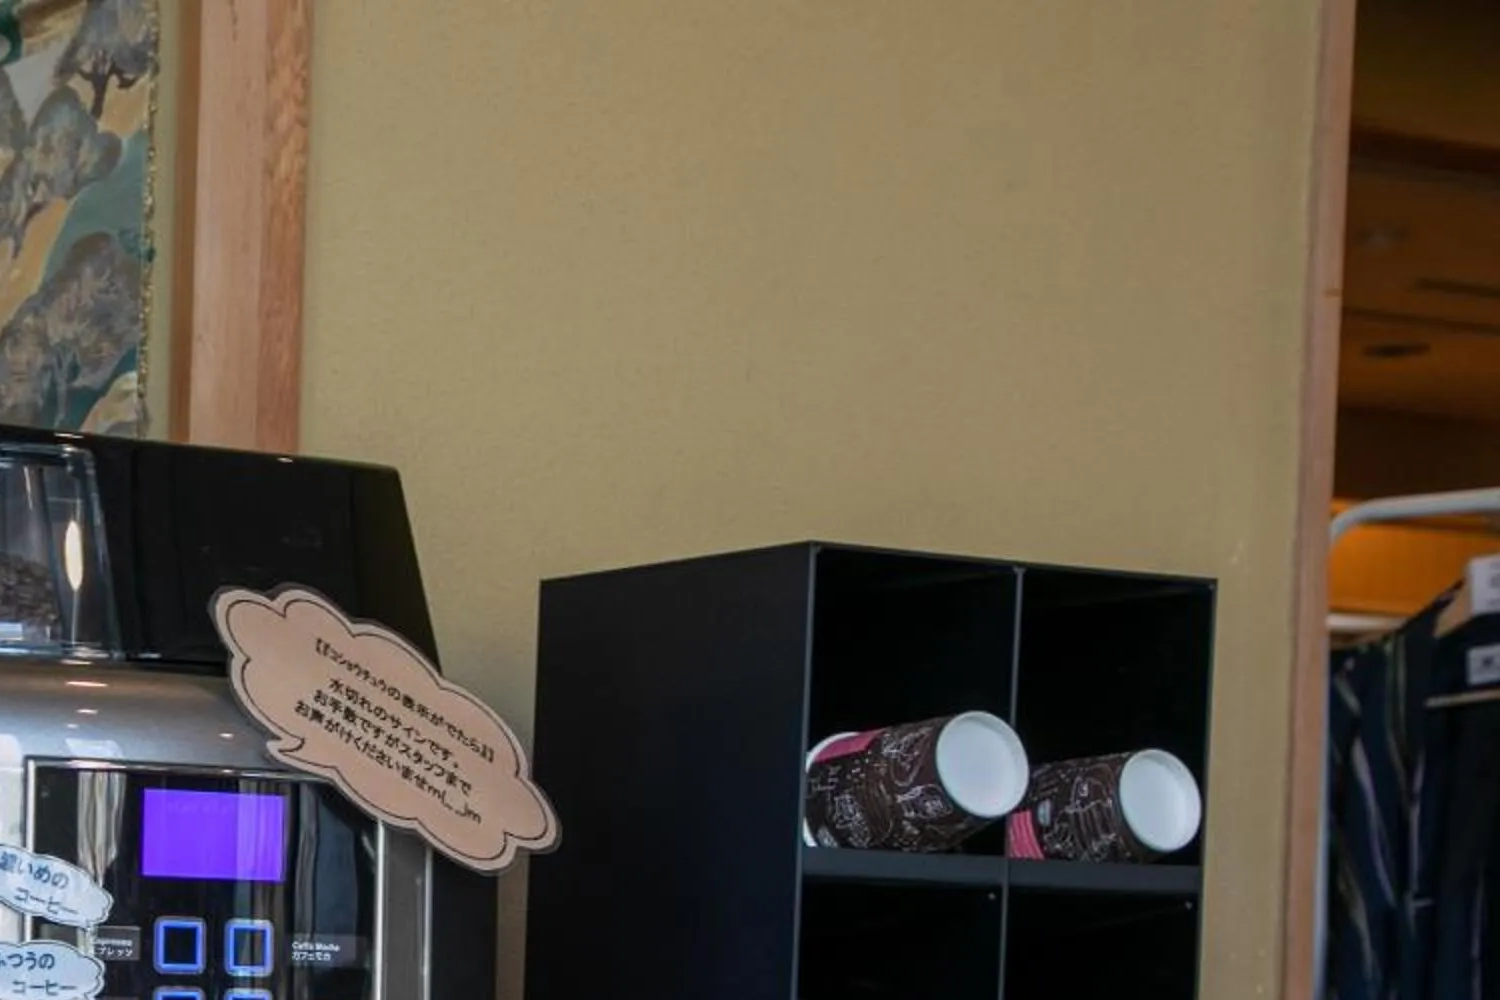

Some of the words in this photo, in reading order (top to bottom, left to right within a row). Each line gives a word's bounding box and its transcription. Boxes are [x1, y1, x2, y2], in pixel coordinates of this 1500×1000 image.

[14, 886, 78, 915] コーヒー
[12, 979, 78, 997] コーヒー
